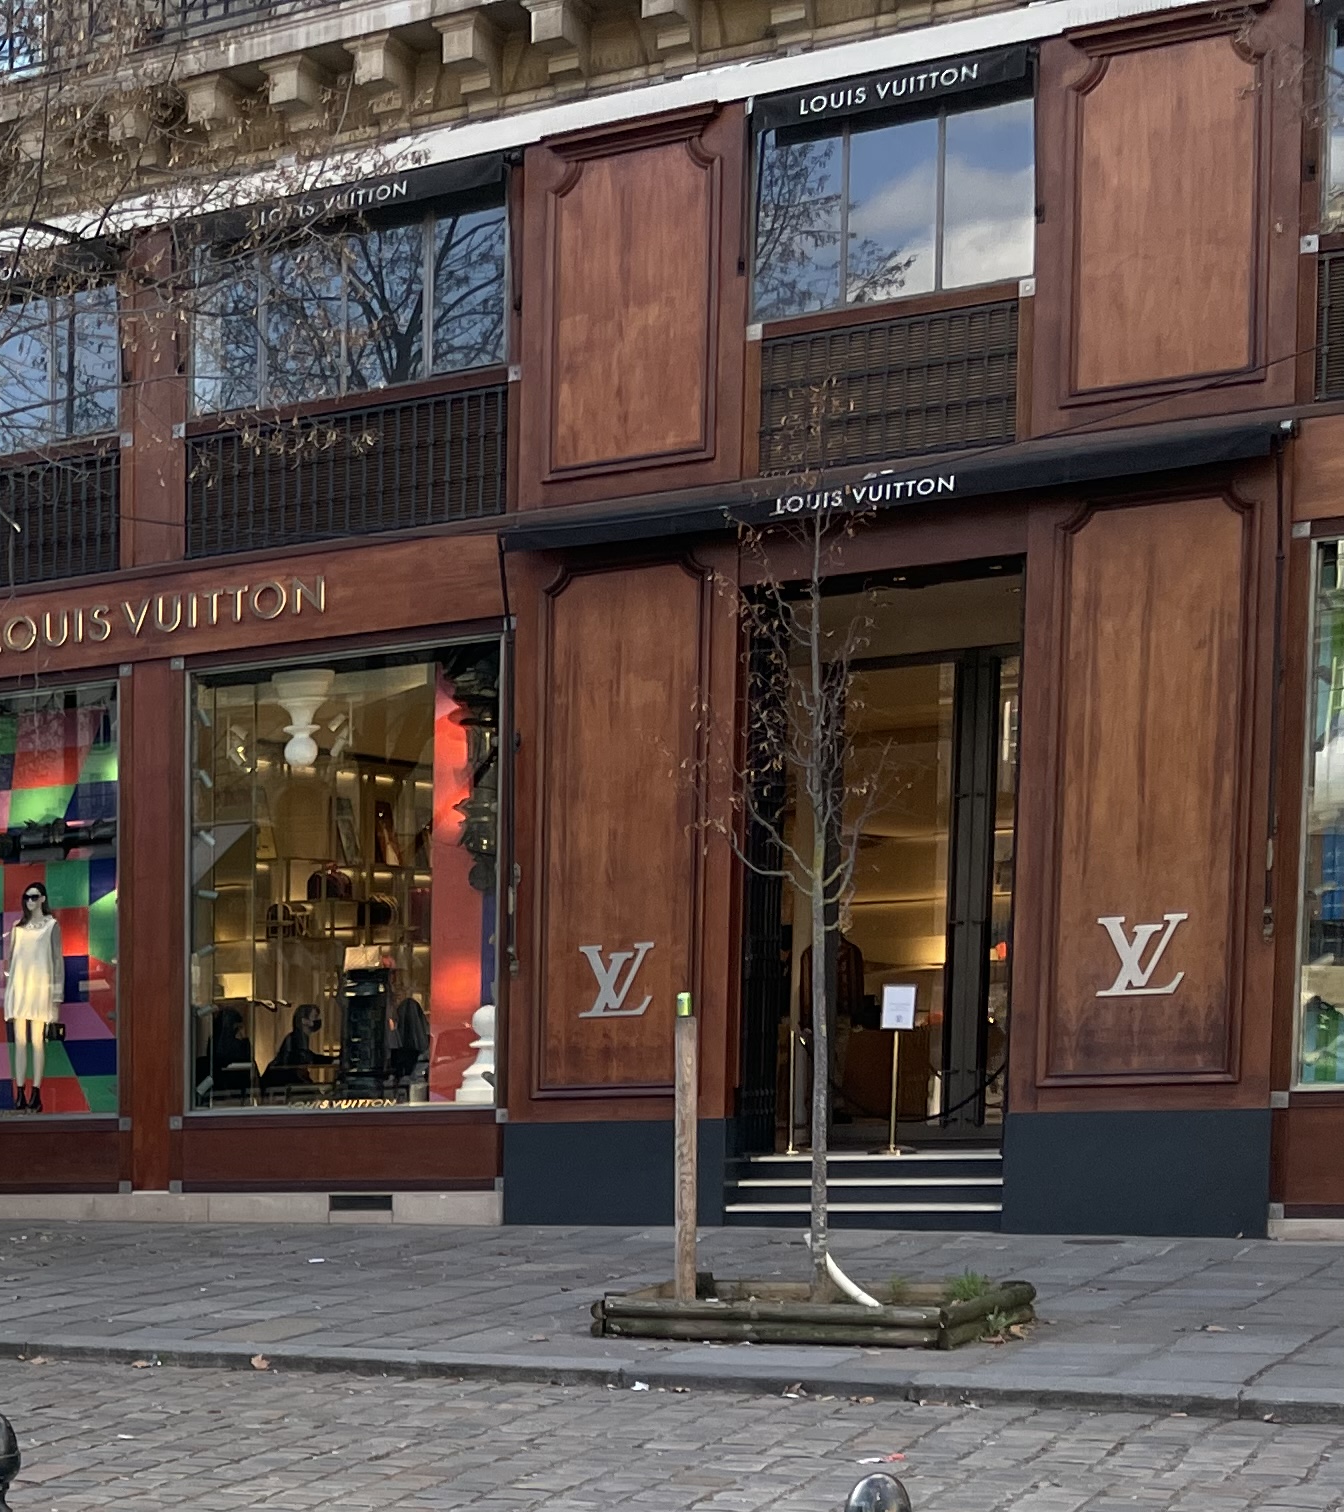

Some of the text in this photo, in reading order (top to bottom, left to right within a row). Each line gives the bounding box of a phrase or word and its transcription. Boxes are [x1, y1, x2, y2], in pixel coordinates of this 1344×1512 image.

[799, 63, 979, 116] LOUIS VUITTON
[260, 204, 315, 226] LOIS
[774, 475, 956, 516] LOUIS VUITTON
[120, 576, 326, 638] VUITTON
[332, 1098, 397, 1109] VUITTON
